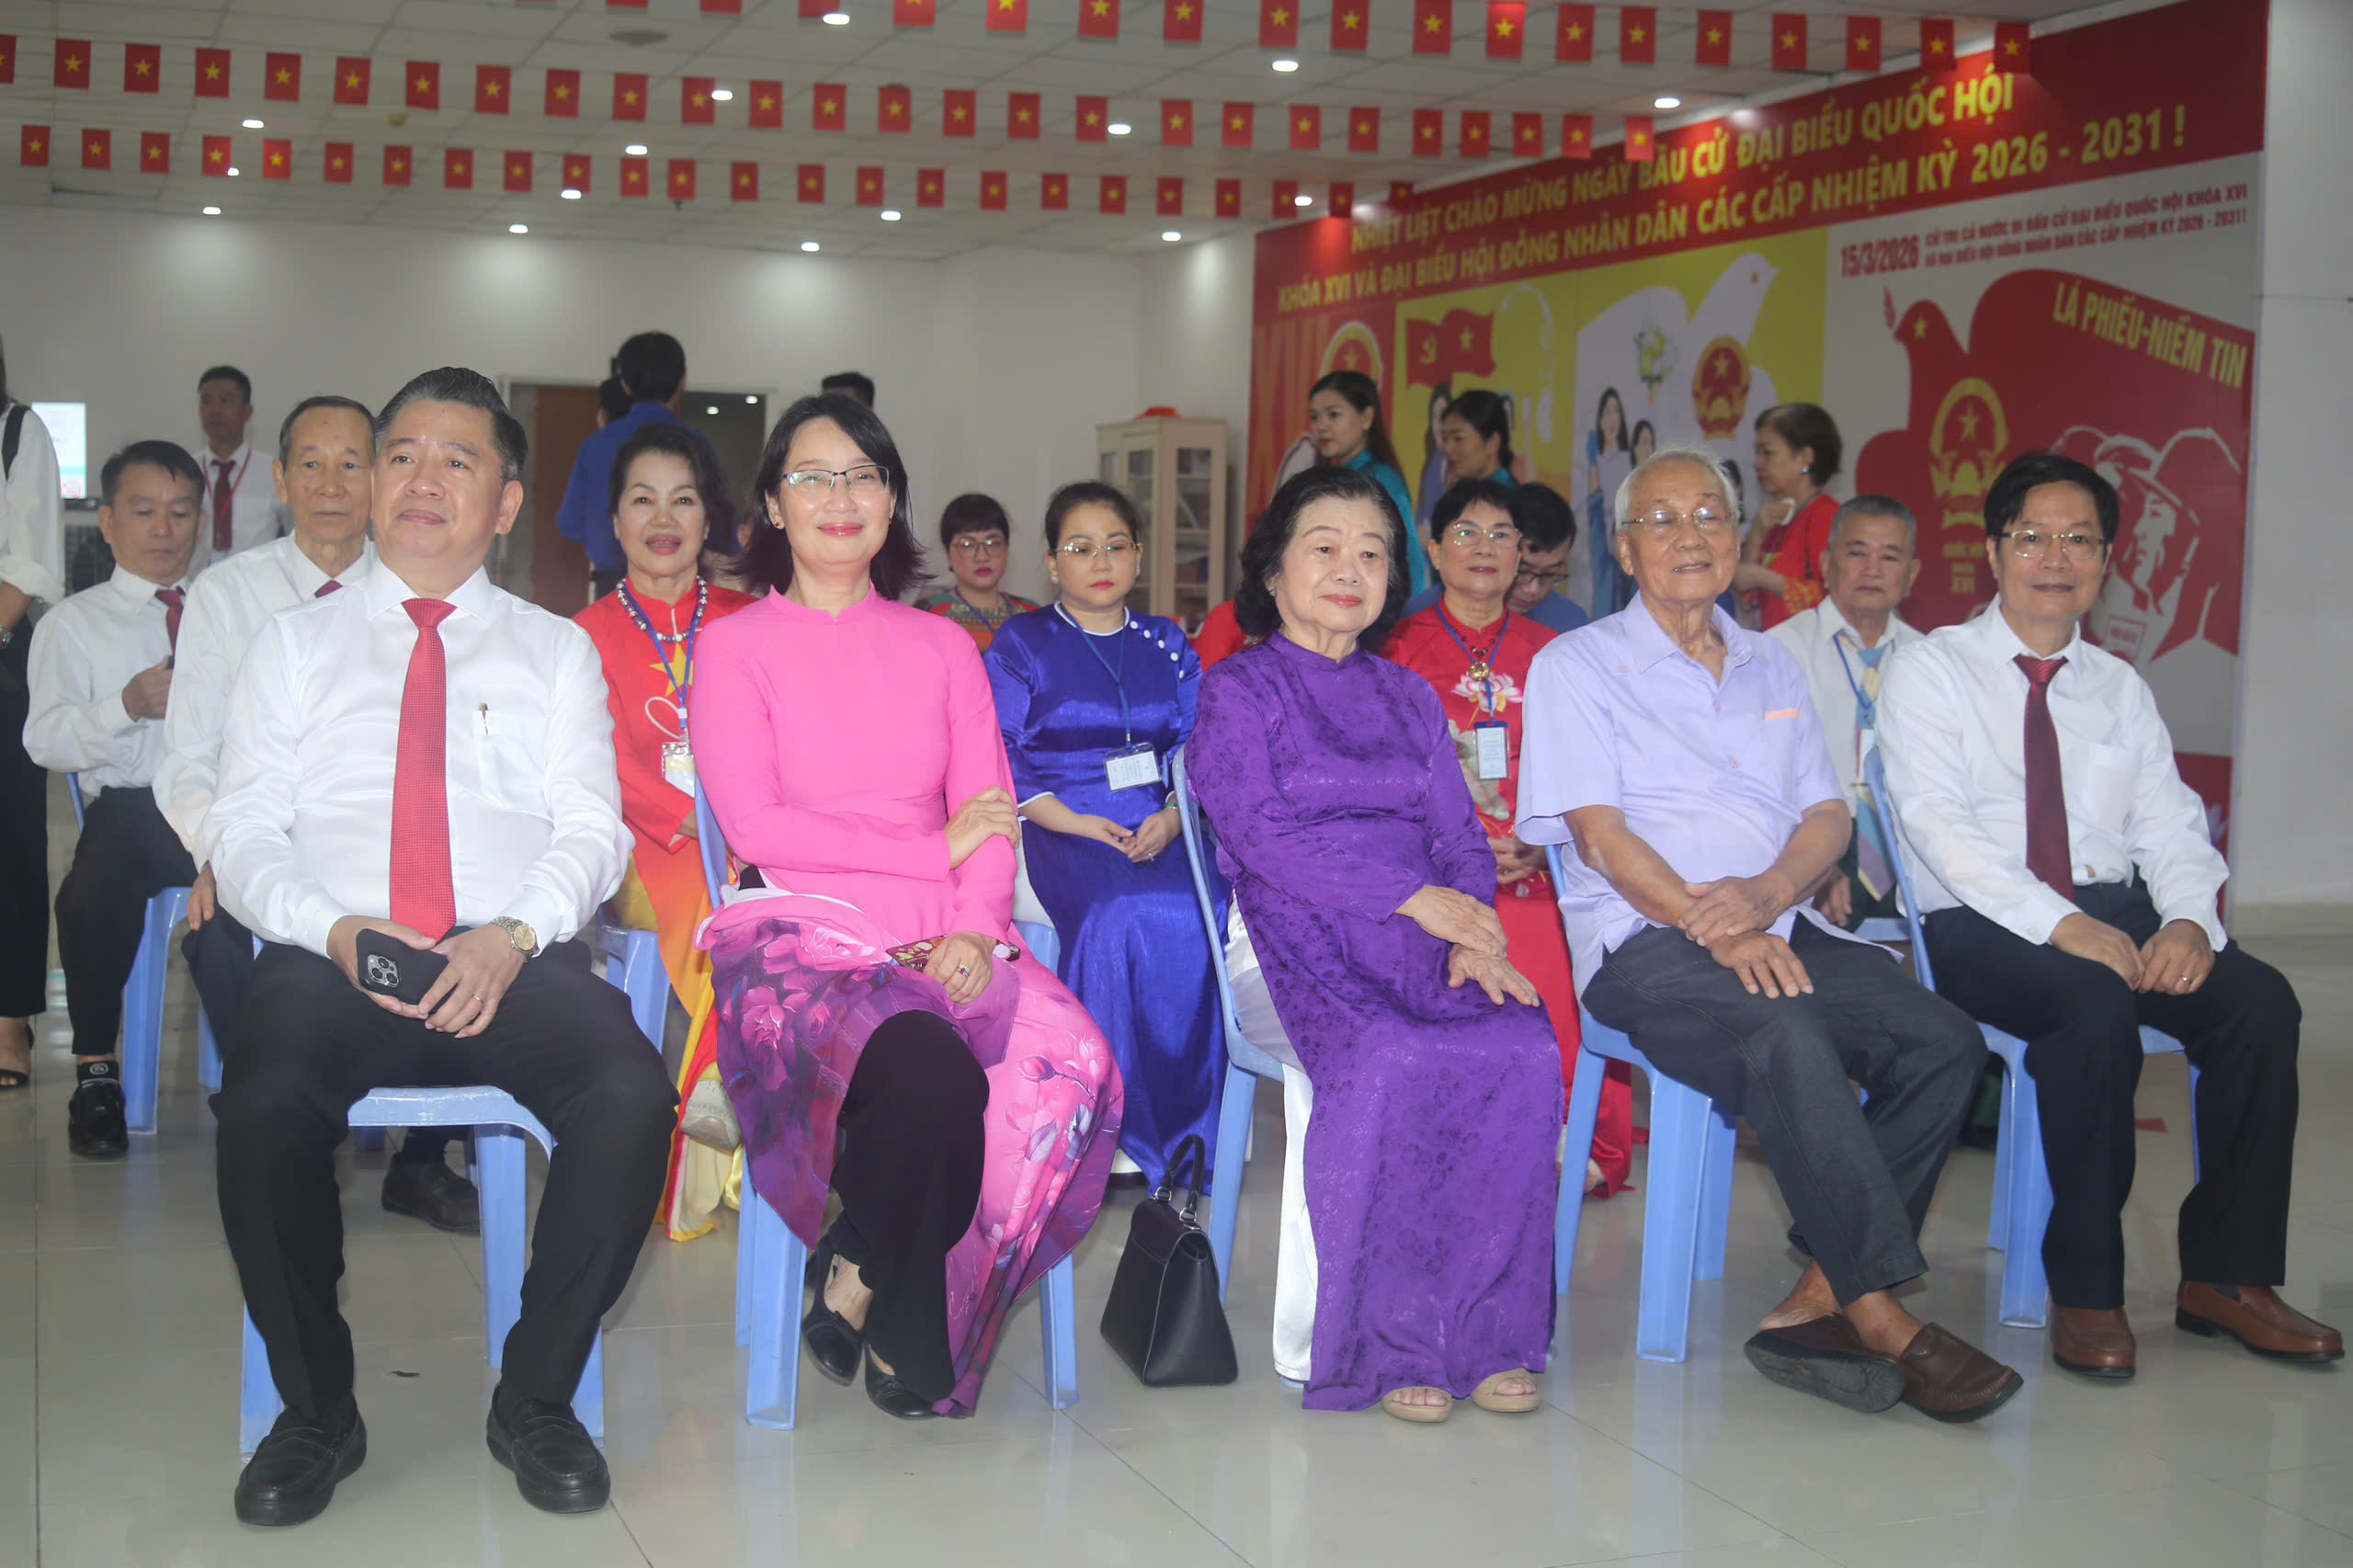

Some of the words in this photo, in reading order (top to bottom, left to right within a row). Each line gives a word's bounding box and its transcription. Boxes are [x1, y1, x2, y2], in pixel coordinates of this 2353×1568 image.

[1279, 277, 1320, 312] KHÓA
[1324, 273, 1350, 304] XVI
[1355, 260, 1377, 298] VÀ
[1381, 263, 1412, 296] ĐẠI
[1416, 242, 1456, 287] BIỂU
[1461, 236, 1495, 280] HỘI
[1499, 227, 1557, 271] ĐỒNG
[1564, 215, 1629, 257] NHÂN
[1635, 200, 1688, 245] DÂN
[1698, 187, 1745, 233] CÁC
[1752, 172, 1804, 222] CẤP
[1812, 156, 1907, 210] NHIỆM
[1917, 139, 1957, 192] KỲ
[1972, 132, 2048, 182] 2026
[2082, 108, 2161, 164] 2031
[2174, 105, 2186, 147] !
[1405, 208, 1441, 245] LIỆT
[1445, 193, 1497, 233] CHÀO
[1503, 177, 1568, 218] MỪNG
[1573, 163, 1633, 208] NGÀY
[1692, 127, 1729, 177] CỬ
[1736, 126, 1782, 172] ĐẠI
[1792, 97, 1853, 155] BIỂU
[1862, 78, 1947, 141] QUỐC
[1954, 63, 2013, 124] HỘI
[1842, 234, 1919, 278] 15/3/2026
[2052, 279, 2081, 328] LÁ
[2210, 336, 2247, 390] TIN
